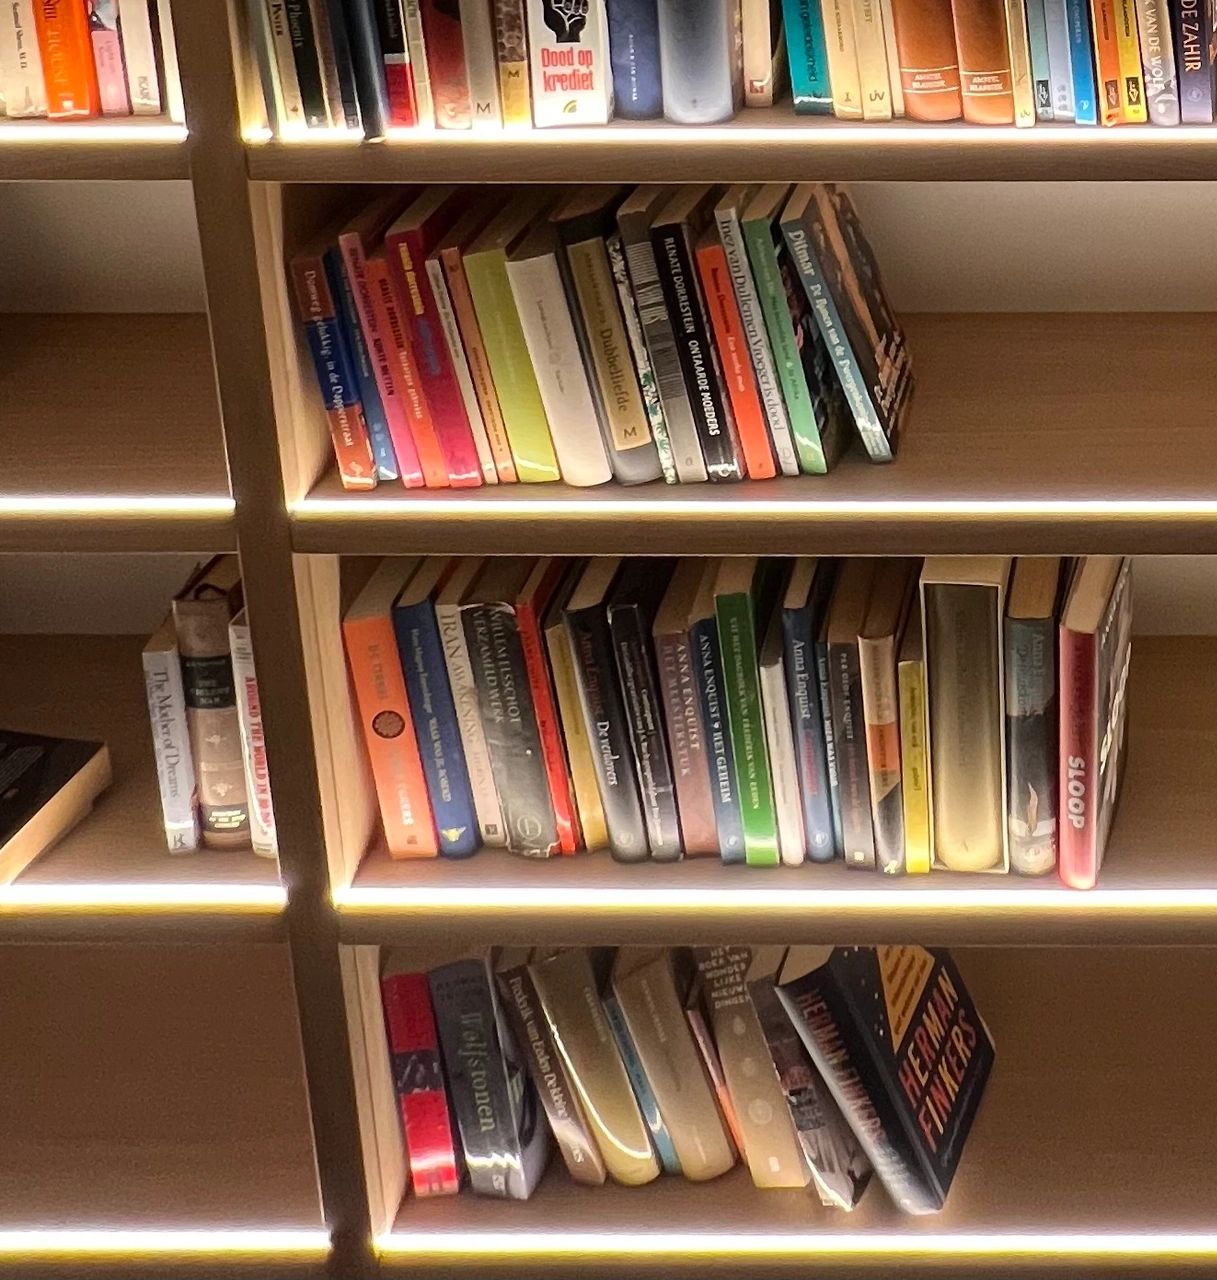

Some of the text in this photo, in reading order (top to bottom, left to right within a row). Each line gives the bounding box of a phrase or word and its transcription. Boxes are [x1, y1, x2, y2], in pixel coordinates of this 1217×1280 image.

[1146, 8, 1158, 33] VAN
[1149, 36, 1161, 54] DE
[541, 47, 594, 70] Dood op
[1181, 22, 1203, 73] ZAHIR
[543, 70, 594, 93] krediet
[1151, 56, 1166, 92] WOLF
[664, 236, 721, 437] RENATE DORRESTEIN ONTAARDE MOEDERS
[600, 327, 630, 413] Dubbelliefde
[152, 668, 169, 693] The
[157, 694, 173, 735] Mother
[699, 633, 733, 804] ANNA ENQUIST HET GEHEIM
[166, 752, 181, 798] Dreams
[597, 720, 620, 787] De verdovers
[1067, 754, 1087, 830] SLOOP
[798, 987, 850, 1065] HERMAN
[898, 966, 959, 1110] HERMAN
[917, 1008, 978, 1154] FINKERS
